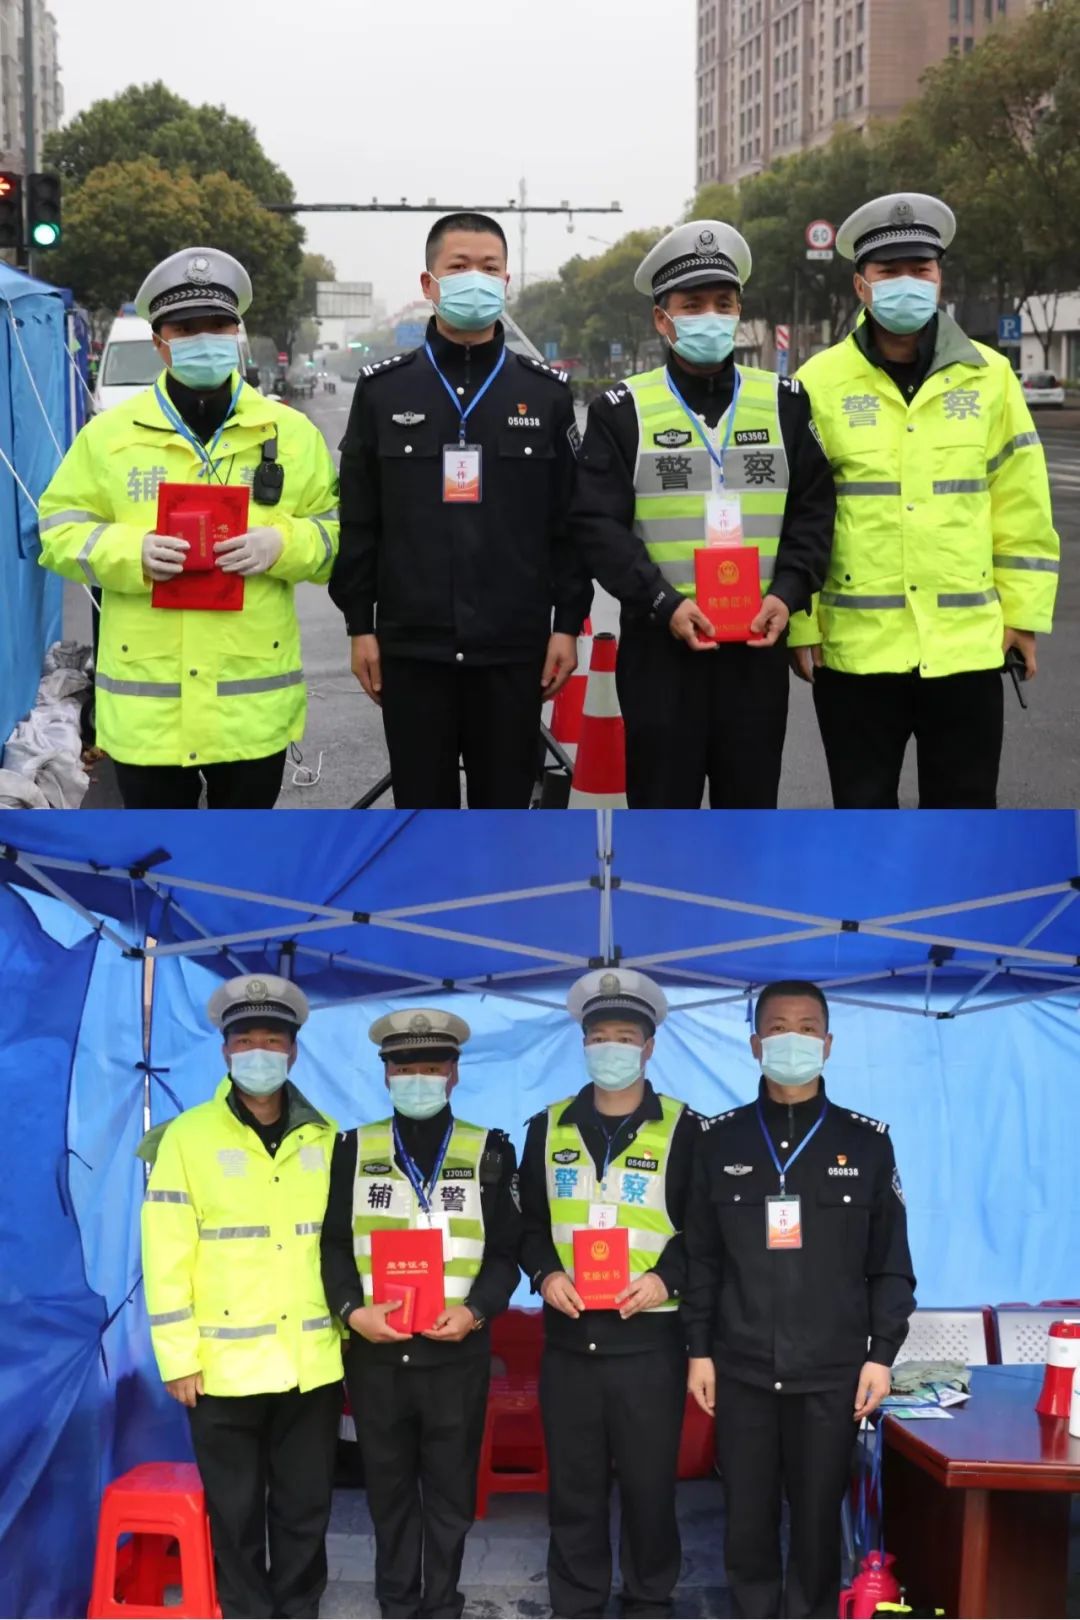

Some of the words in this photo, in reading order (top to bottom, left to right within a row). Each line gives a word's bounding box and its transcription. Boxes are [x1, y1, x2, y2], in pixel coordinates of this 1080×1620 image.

[812, 229, 829, 243] 60
[1003, 319, 1016, 338] P
[841, 394, 881, 428] 警
[943, 388, 981, 420] 察
[508, 416, 541, 427] 050838
[655, 454, 693, 490] 警
[743, 451, 776, 484] 察
[445, 1169, 473, 1178] JJ0105
[828, 1167, 859, 1176] 050838
[555, 1167, 578, 1198] 警
[621, 1173, 649, 1203] 察
[367, 1183, 394, 1209] 辅
[440, 1185, 467, 1212] 警
